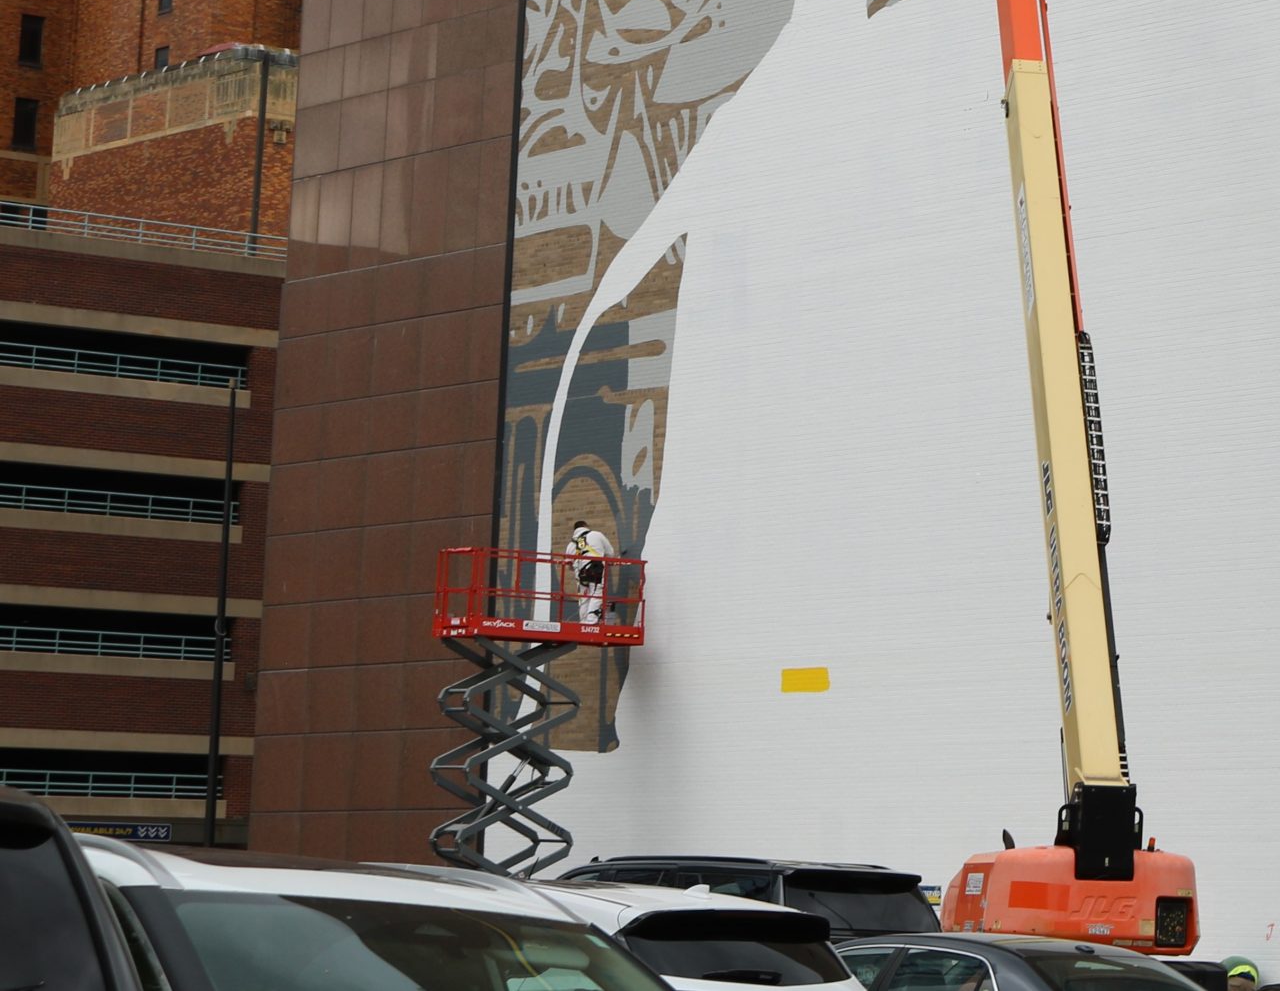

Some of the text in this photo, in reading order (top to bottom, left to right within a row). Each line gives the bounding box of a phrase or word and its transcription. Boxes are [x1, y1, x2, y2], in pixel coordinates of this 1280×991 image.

[482, 619, 515, 628] SKYJACK
[1049, 523, 1063, 618] ULTRA
[1059, 619, 1072, 713] BOOM
[1069, 895, 1136, 921] JLG
